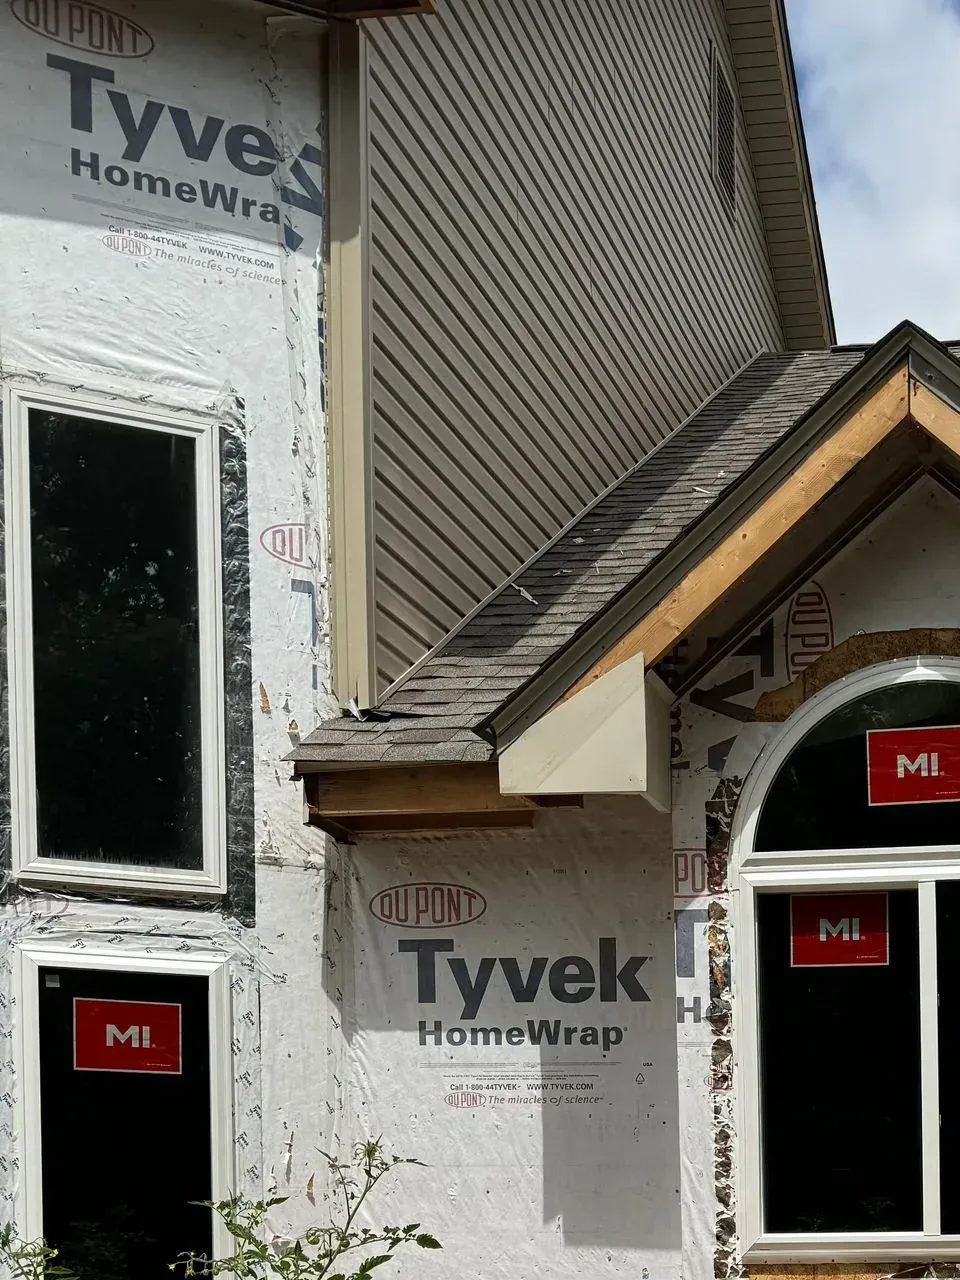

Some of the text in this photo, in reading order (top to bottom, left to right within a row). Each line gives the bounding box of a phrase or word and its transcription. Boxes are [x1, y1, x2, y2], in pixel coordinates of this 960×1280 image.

[108, 225, 125, 235] Call
[199, 245, 275, 270] WWW.TYVEK.COM
[154, 248, 174, 261] The
[177, 255, 222, 272] miracles
[225, 266, 241, 278] of
[897, 753, 938, 778] MI
[819, 918, 860, 941] MI
[398, 937, 652, 1020] Tyvek
[106, 1024, 150, 1048] MI
[418, 1019, 623, 1051] HomeWrap
[450, 1083, 464, 1091] Call
[527, 1083, 594, 1091] WWW.TYVEK.COM
[488, 1095, 505, 1104] The
[508, 1095, 547, 1104] miracles
[550, 1095, 563, 1105] of
[564, 1095, 599, 1104] science
